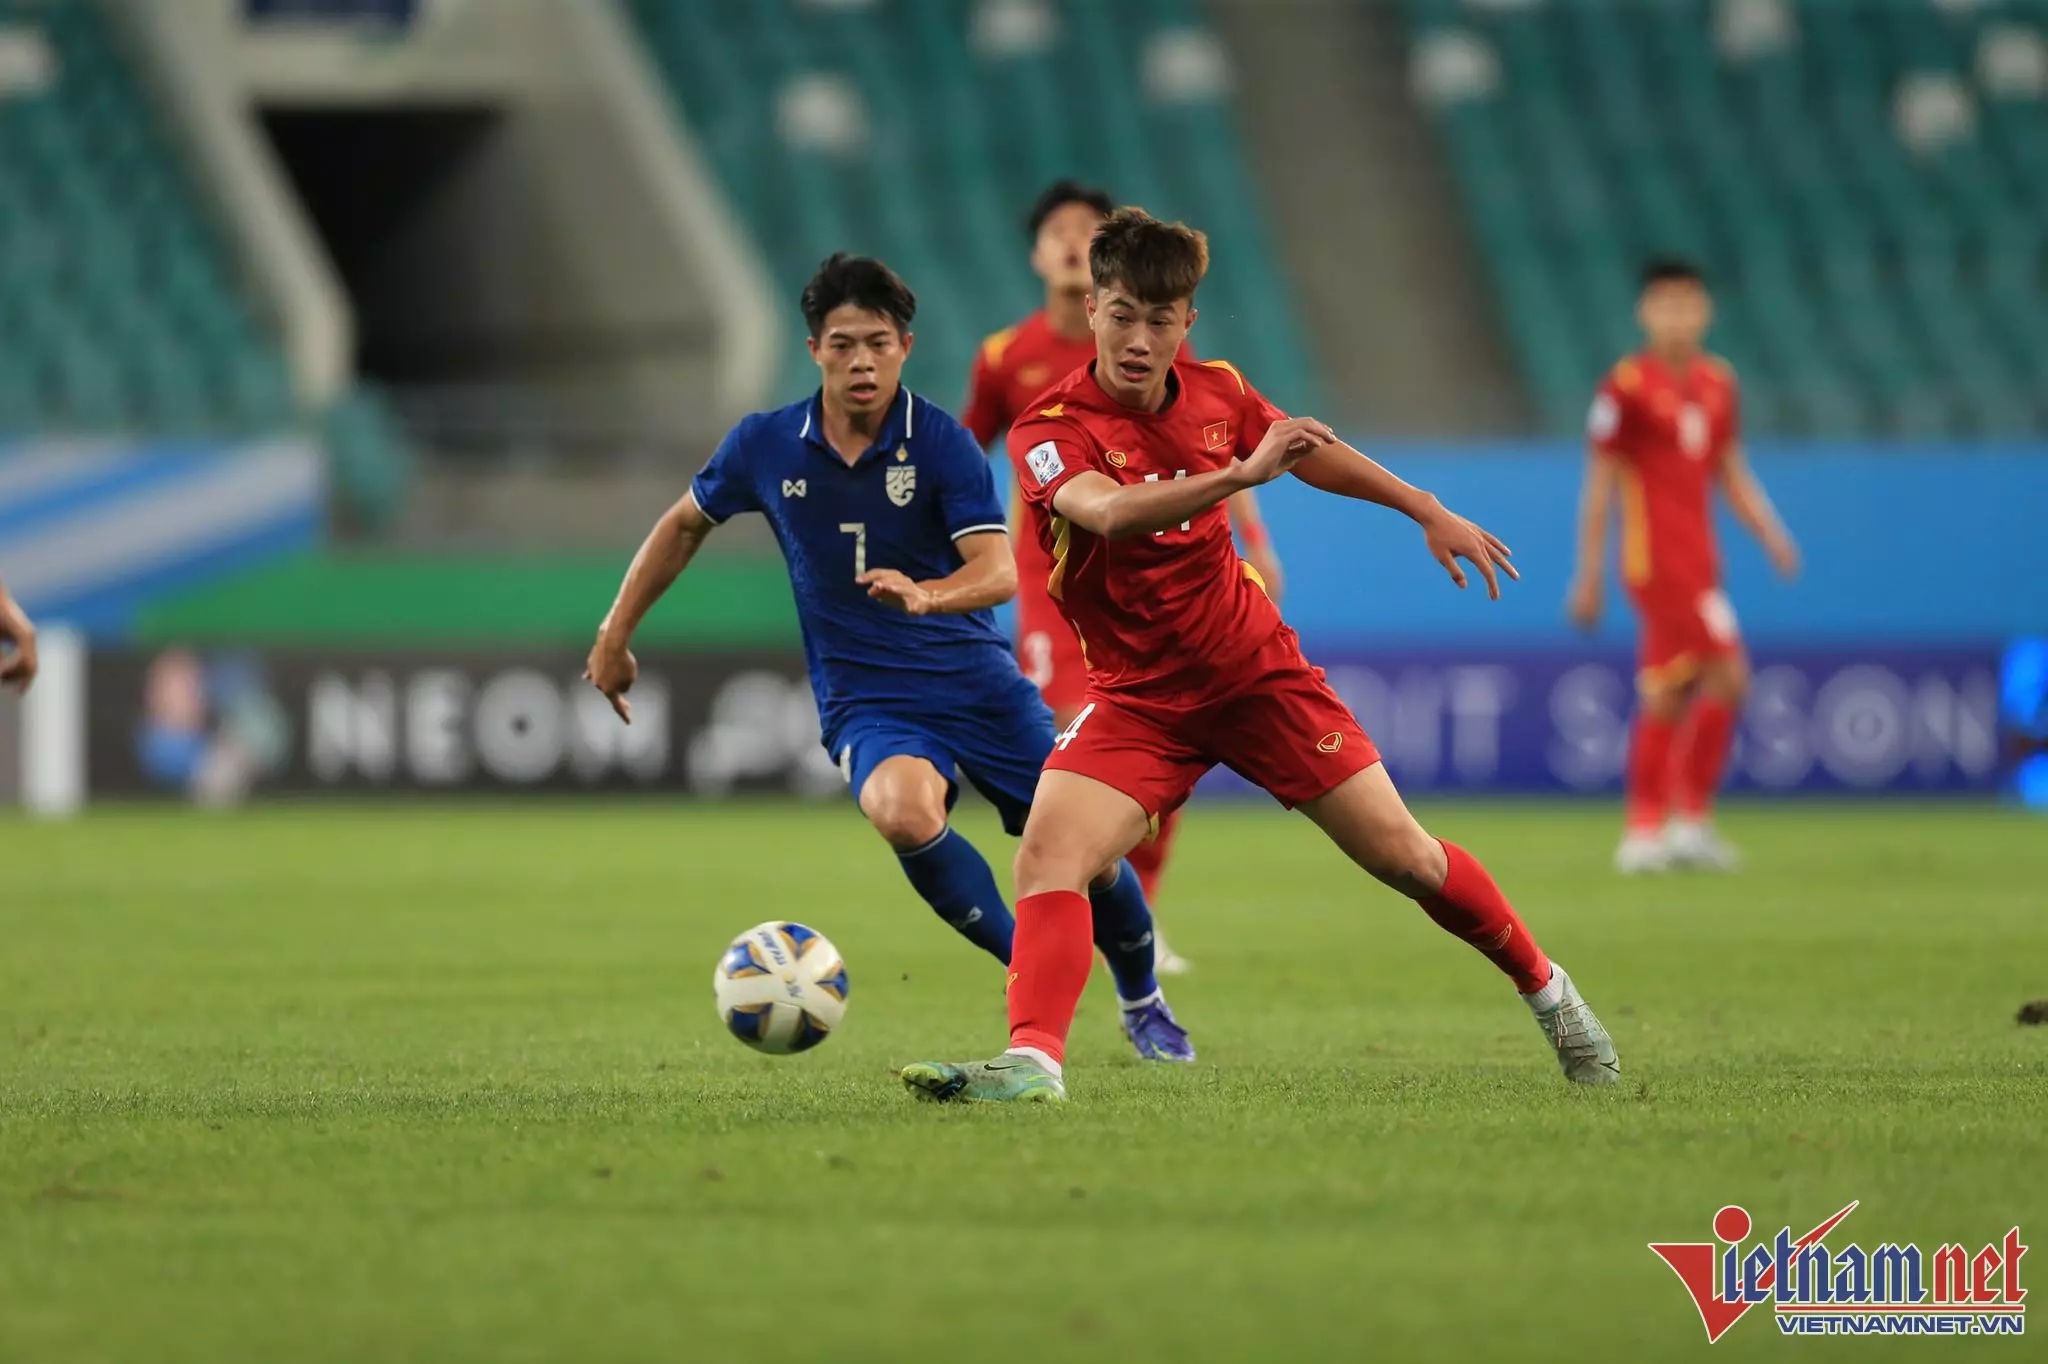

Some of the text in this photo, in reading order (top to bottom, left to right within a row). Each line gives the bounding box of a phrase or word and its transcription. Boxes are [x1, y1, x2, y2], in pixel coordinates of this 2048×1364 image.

[839, 522, 866, 578] 7
[308, 670, 672, 784] NEOM
[1546, 663, 1998, 787] SSON
